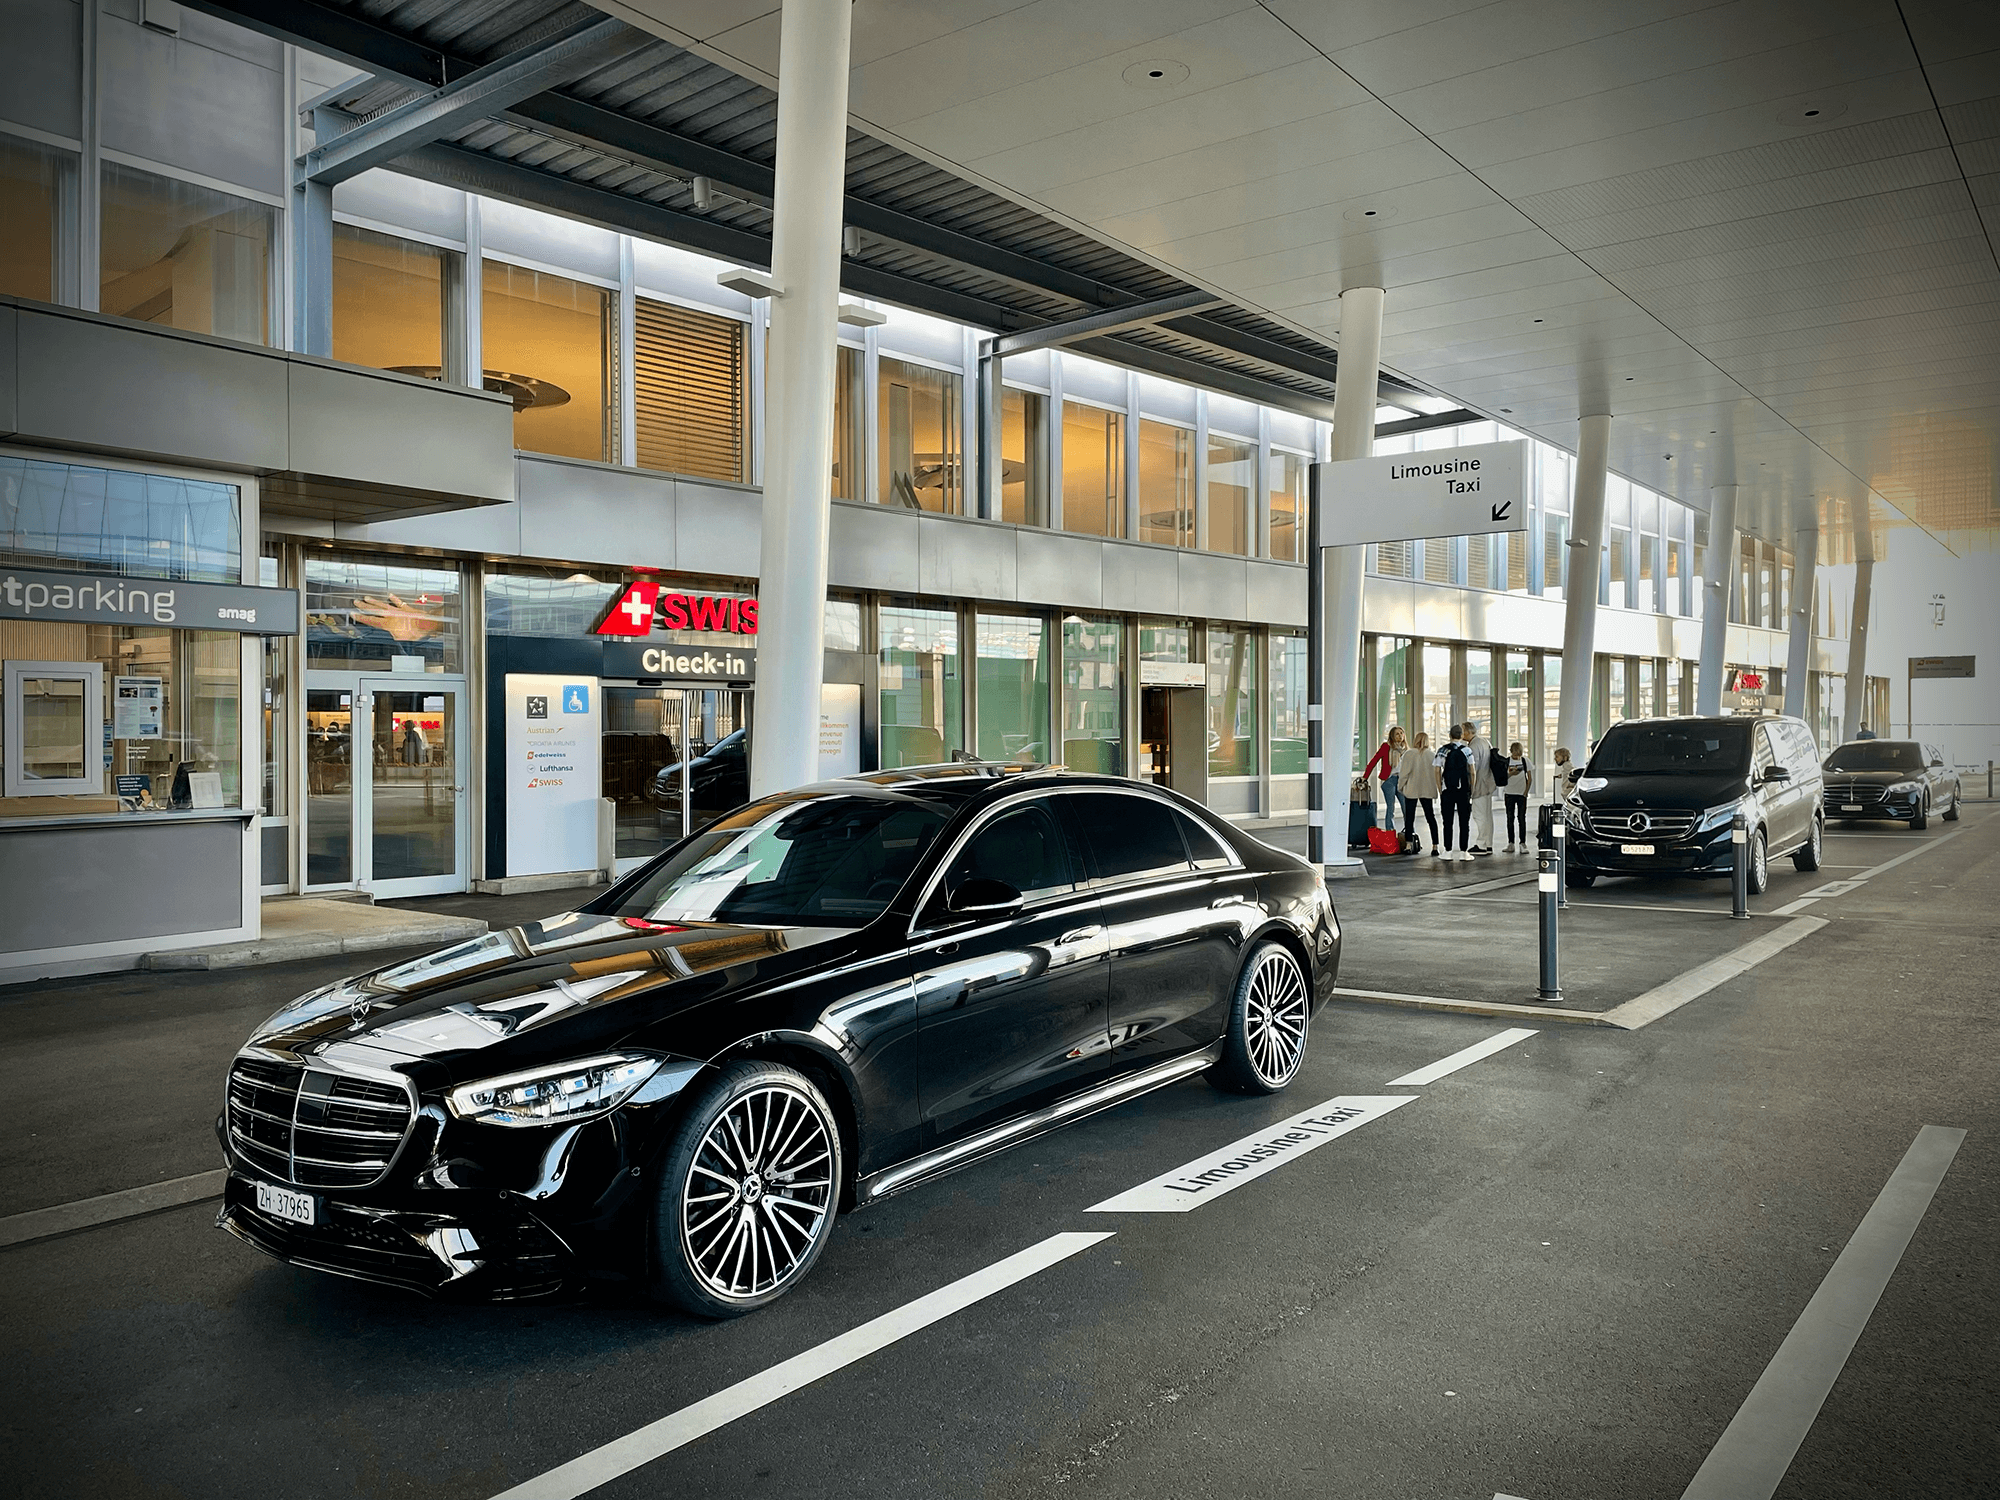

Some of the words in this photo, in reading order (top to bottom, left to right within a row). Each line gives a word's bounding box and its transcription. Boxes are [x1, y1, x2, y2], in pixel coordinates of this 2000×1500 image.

[1391, 458, 1481, 480] Limousine
[1446, 477, 1481, 494] Taxi
[0, 576, 176, 623] tparking
[218, 607, 256, 623] amag
[663, 593, 759, 635] SWIS
[642, 648, 746, 676] Check-in
[539, 778, 563, 787] SWISS
[1163, 1131, 1311, 1194] Limousine
[1301, 1106, 1365, 1127] Taxi
[277, 1193, 310, 1220] 37965
